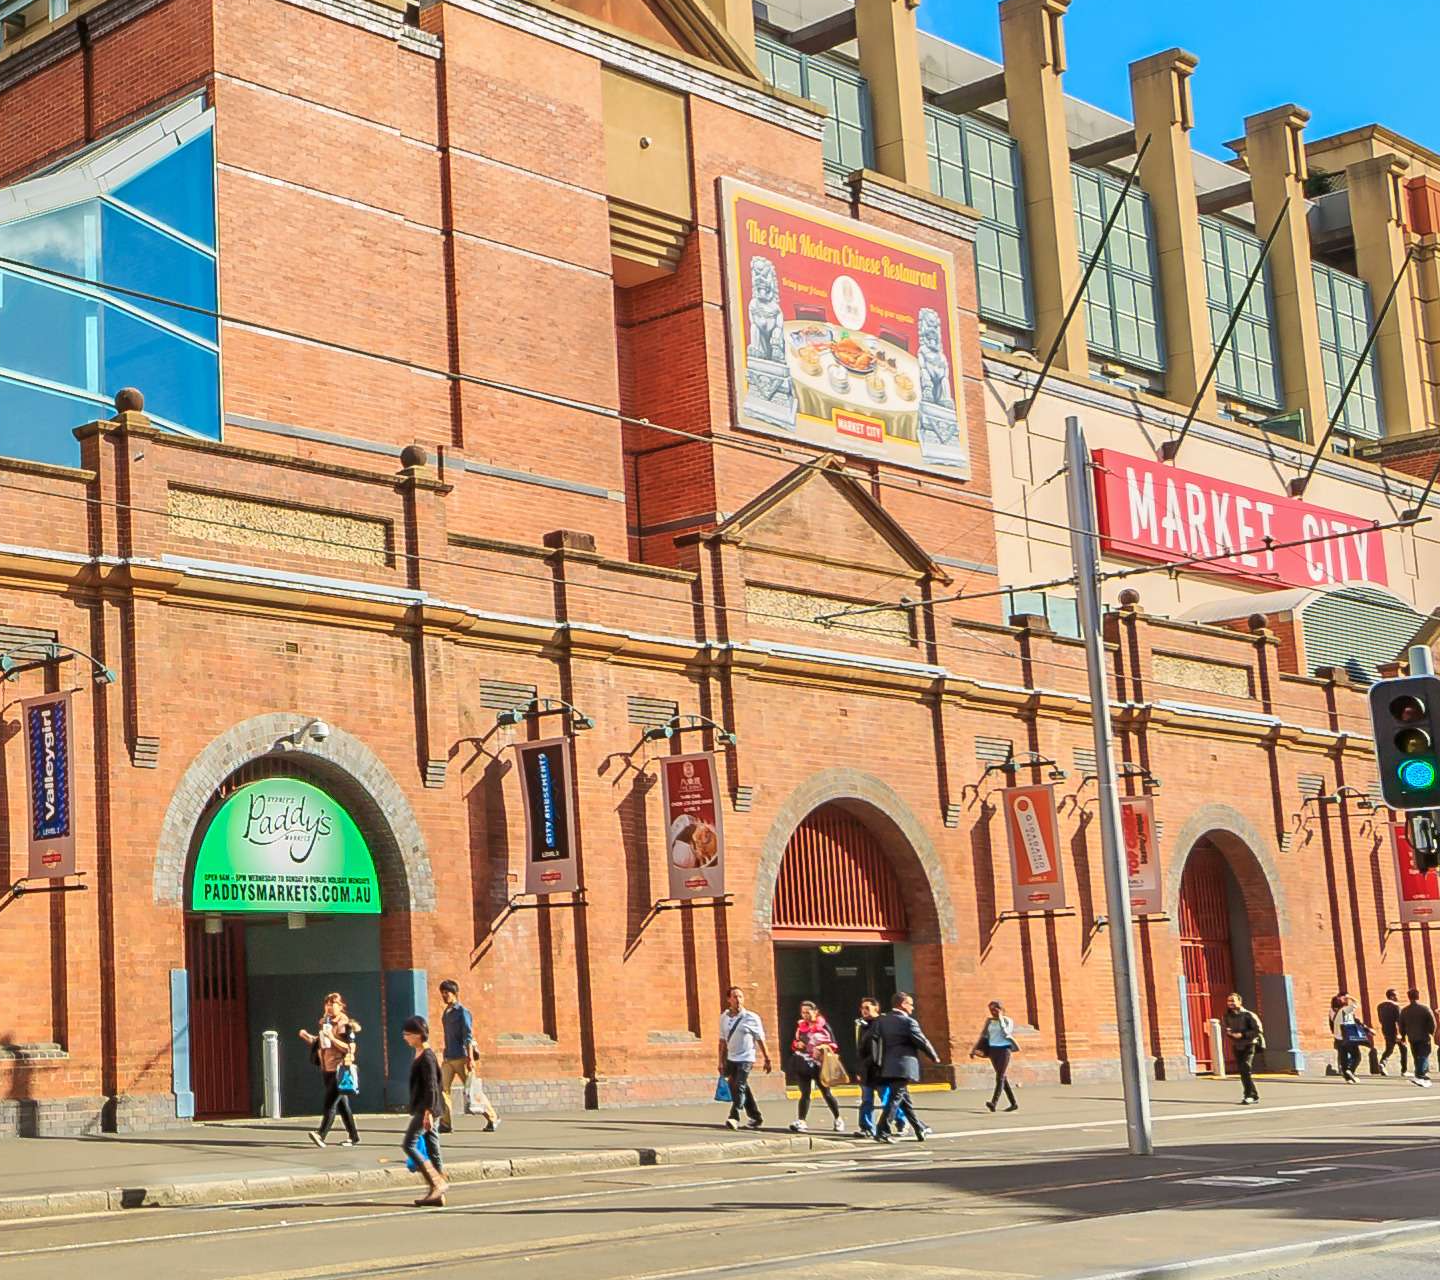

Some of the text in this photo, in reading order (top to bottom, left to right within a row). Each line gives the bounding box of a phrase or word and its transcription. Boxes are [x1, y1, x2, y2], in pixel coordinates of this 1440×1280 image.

[746, 219, 937, 289] The Eight Modern Chinese Restaurant
[837, 418, 881, 438] MARKET CITY
[1126, 466, 1369, 586] MARKET CITY
[41, 709, 55, 821] Valleygirl
[538, 753, 553, 844] CITY AMUSEMENTS
[42, 827, 55, 836] LEVEL
[241, 793, 333, 864] Paddy's
[204, 873, 218, 881] OPEN
[248, 874, 277, 882] WEDNESDAY
[285, 875, 305, 883] SUNDAY
[310, 876, 327, 884] PUBLIC
[328, 877, 347, 885] HOLIDAY
[204, 883, 371, 903] PADDYSMARKETS.COM.AU
